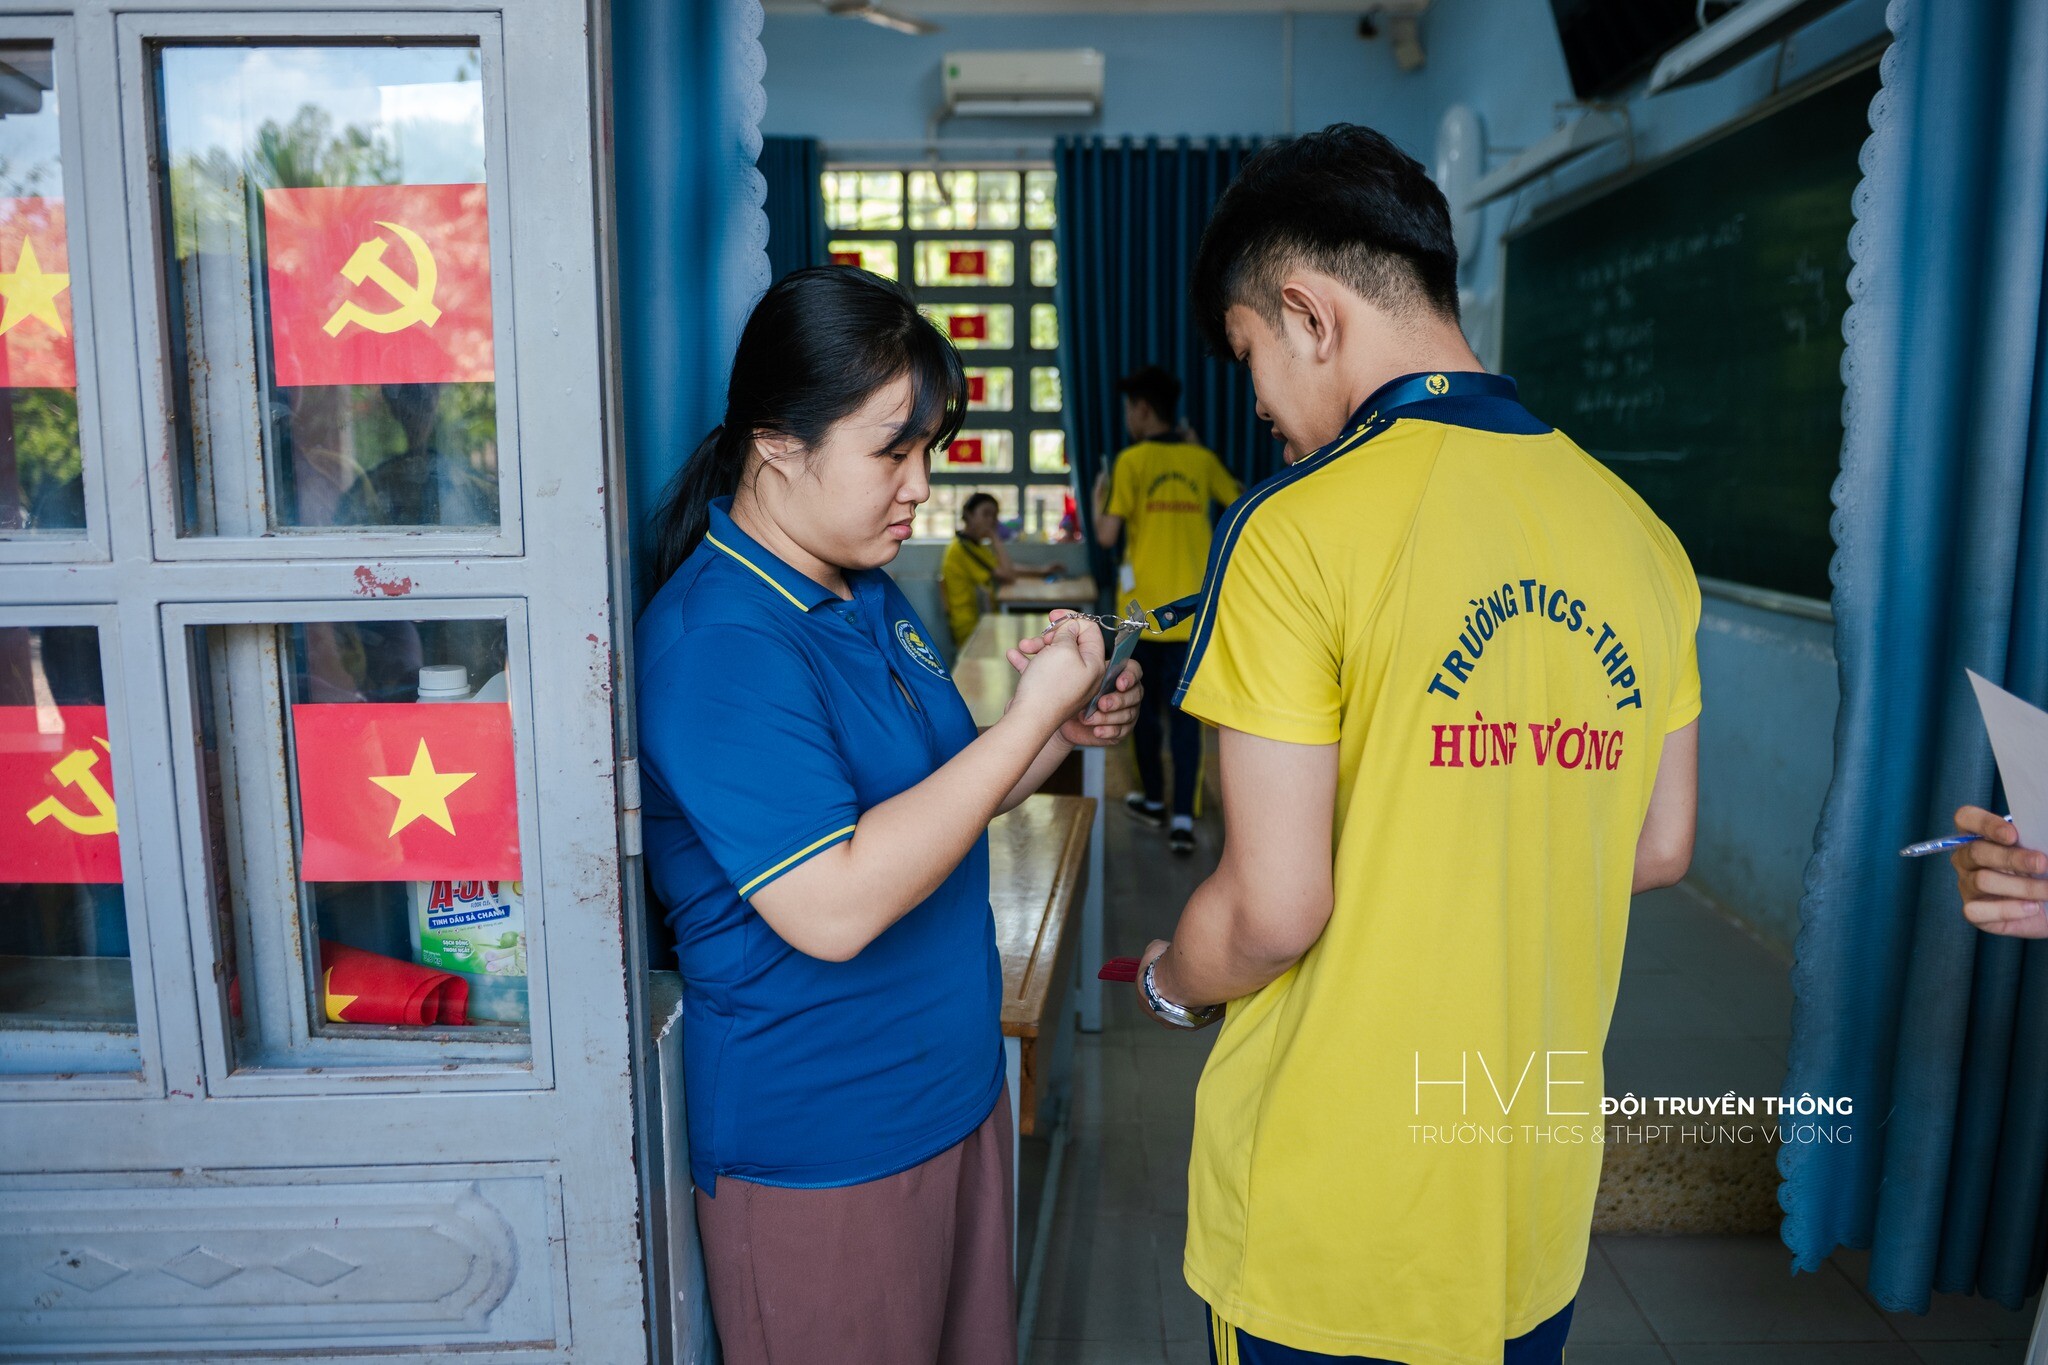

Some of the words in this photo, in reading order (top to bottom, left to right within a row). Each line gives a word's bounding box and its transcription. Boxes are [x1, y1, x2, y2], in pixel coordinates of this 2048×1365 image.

[1427, 583, 1519, 700] TRƯỜNG
[1430, 710, 1517, 768] HÙNG
[1528, 718, 1624, 771] VƠNG
[432, 918, 448, 926] TINH
[477, 908, 505, 920] CHANH
